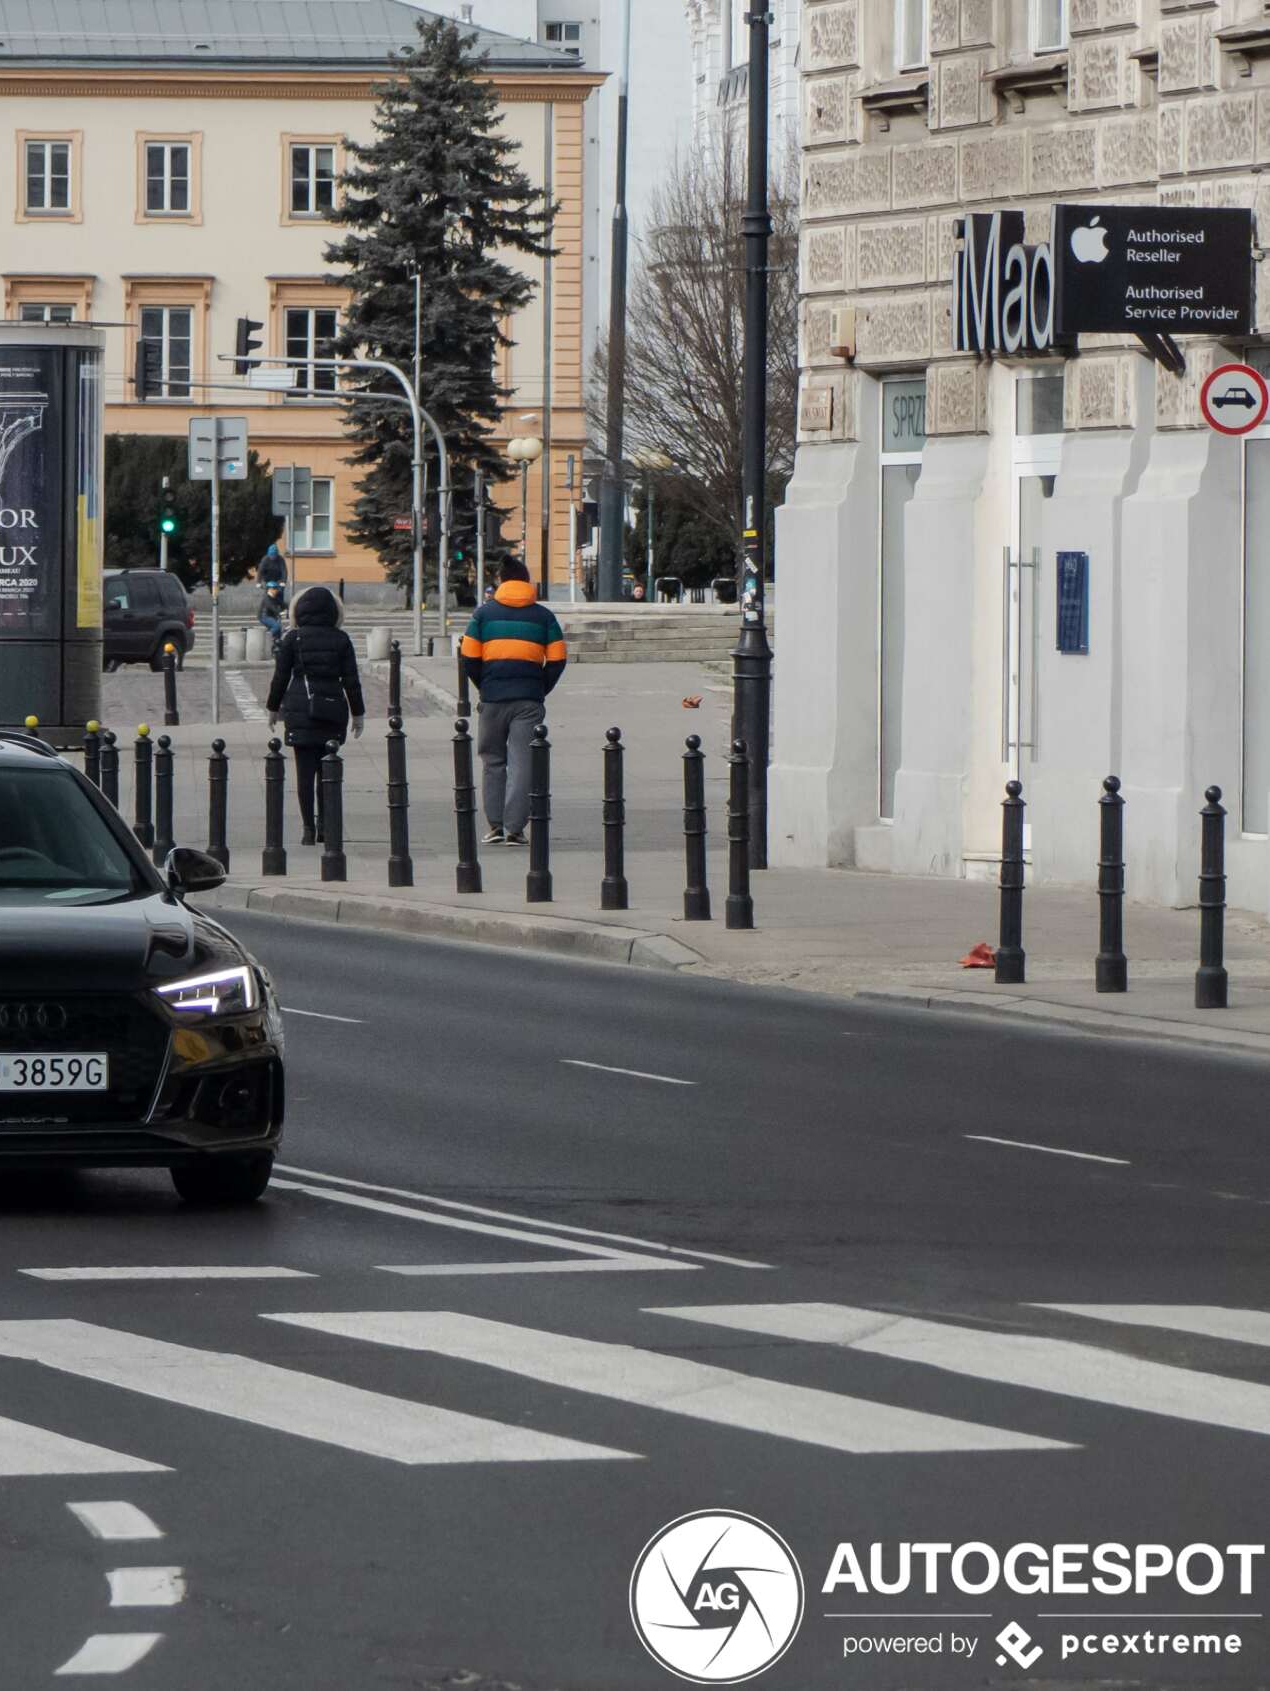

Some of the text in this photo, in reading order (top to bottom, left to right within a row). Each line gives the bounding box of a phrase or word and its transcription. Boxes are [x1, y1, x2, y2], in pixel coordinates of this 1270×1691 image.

[1126, 229, 1205, 243] Authorised
[1126, 248, 1182, 262] Reseller
[952, 204, 1057, 352] iMad
[1125, 285, 1204, 299] Authorised
[1124, 305, 1240, 320] Service Provider
[892, 394, 927, 438] SPRZ
[18, 579, 38, 587] 2020
[13, 1058, 103, 1087] 3859G
